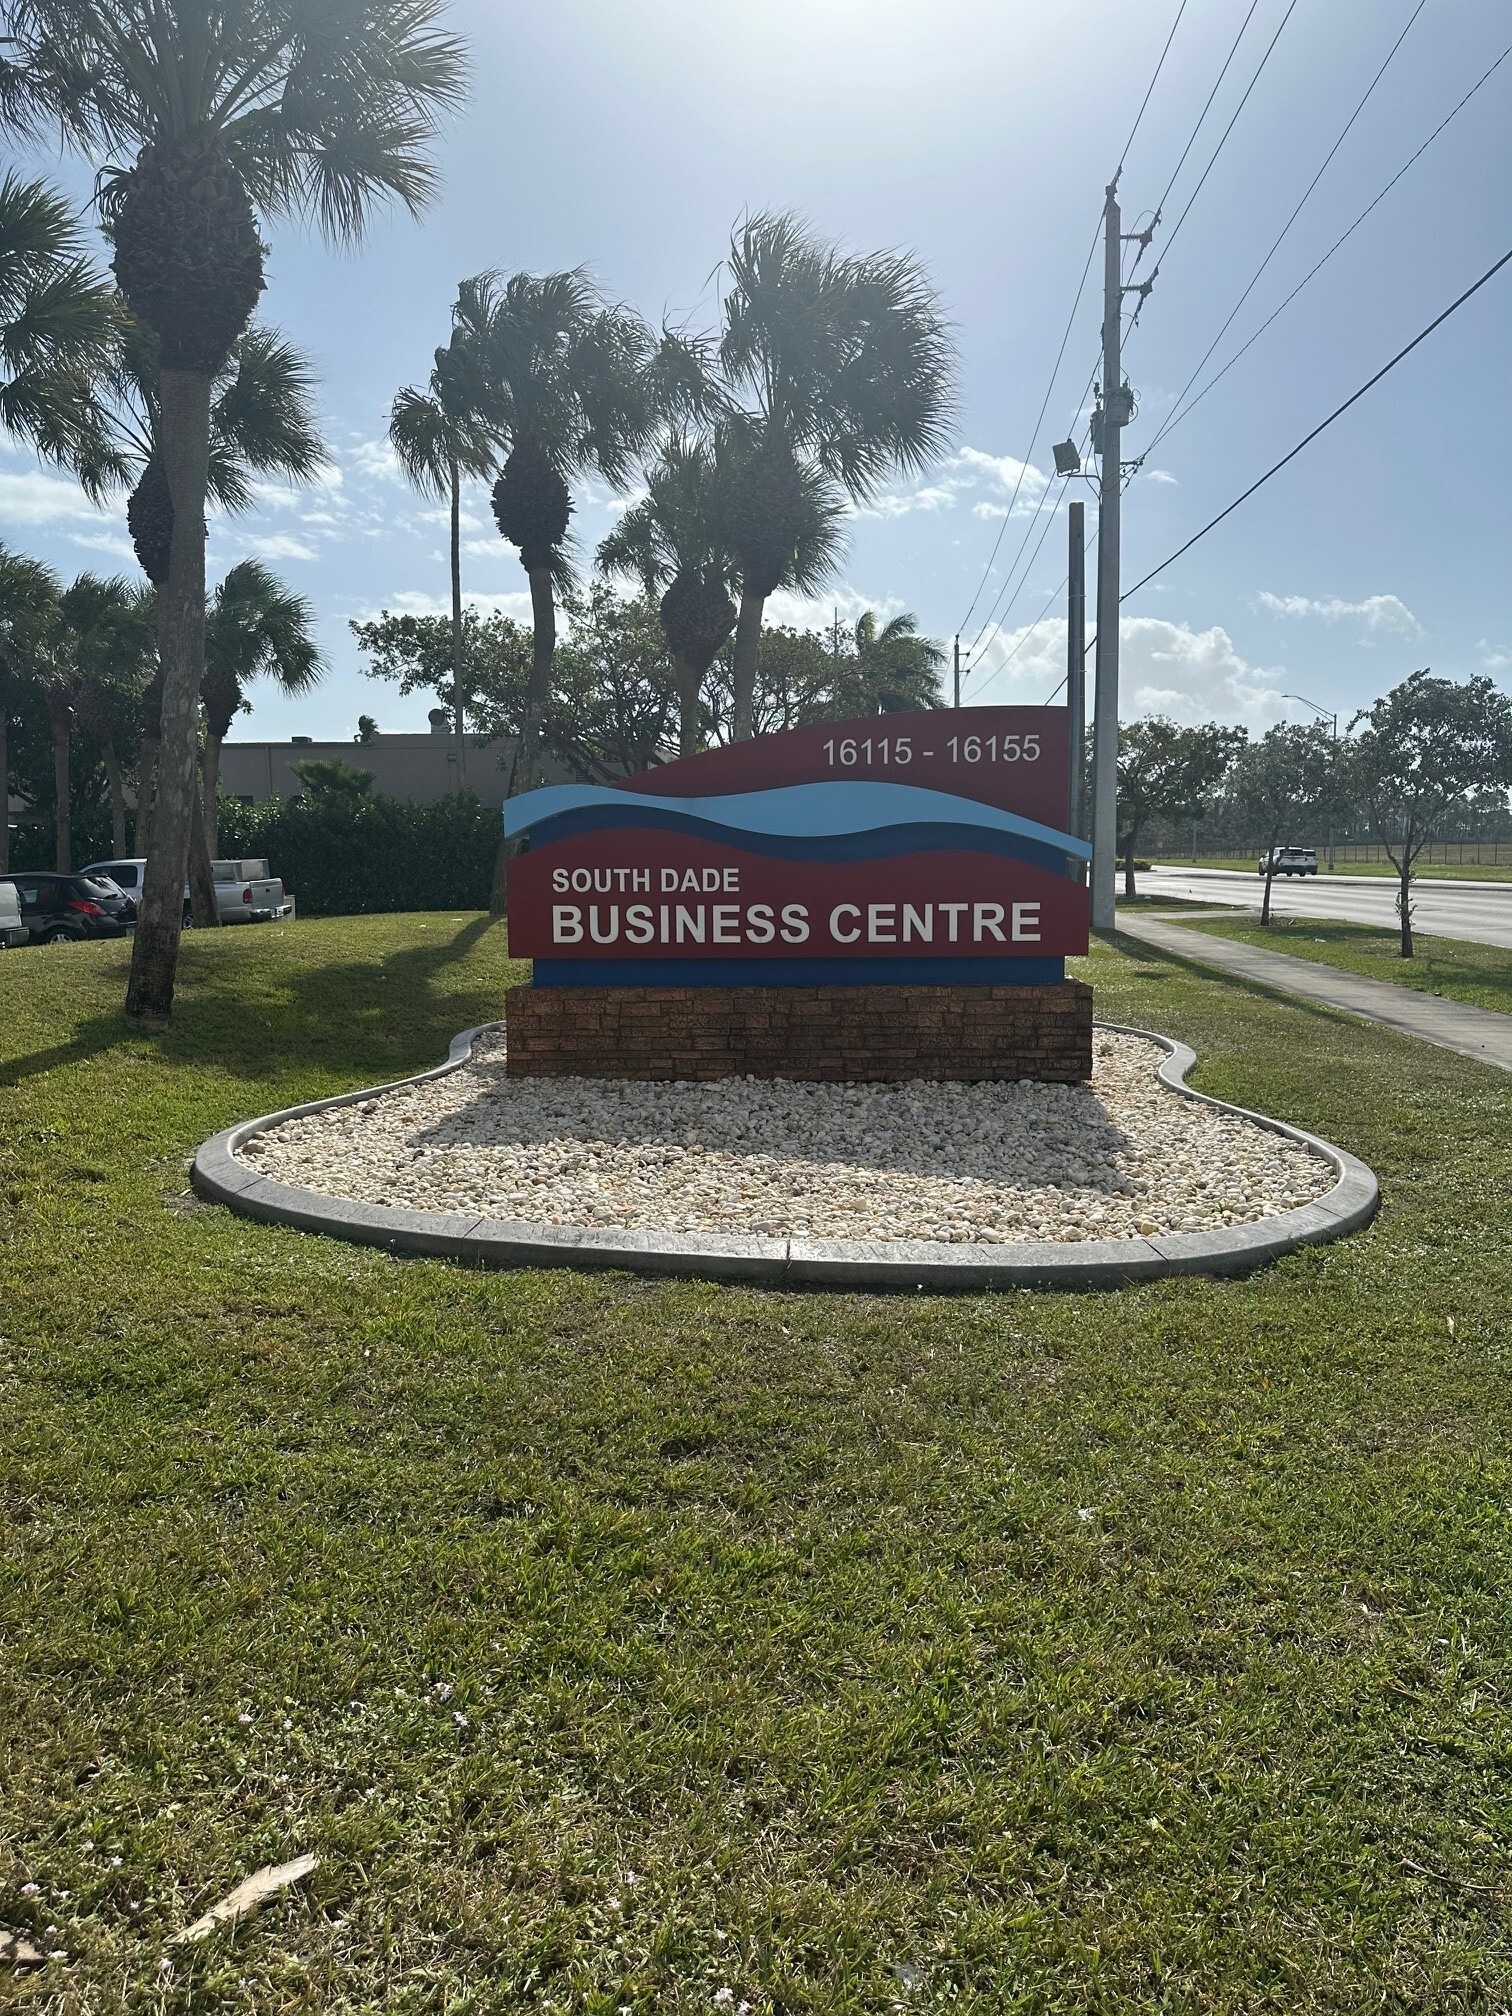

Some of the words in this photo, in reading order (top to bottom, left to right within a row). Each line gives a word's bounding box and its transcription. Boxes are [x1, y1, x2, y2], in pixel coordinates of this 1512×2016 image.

[822, 738, 913, 766] 16115
[946, 734, 1041, 763] 16155
[552, 868, 650, 893] SOUTH
[660, 868, 740, 892] DADE
[552, 904, 810, 944] BUSINESS
[829, 902, 1041, 943] CENTRE
